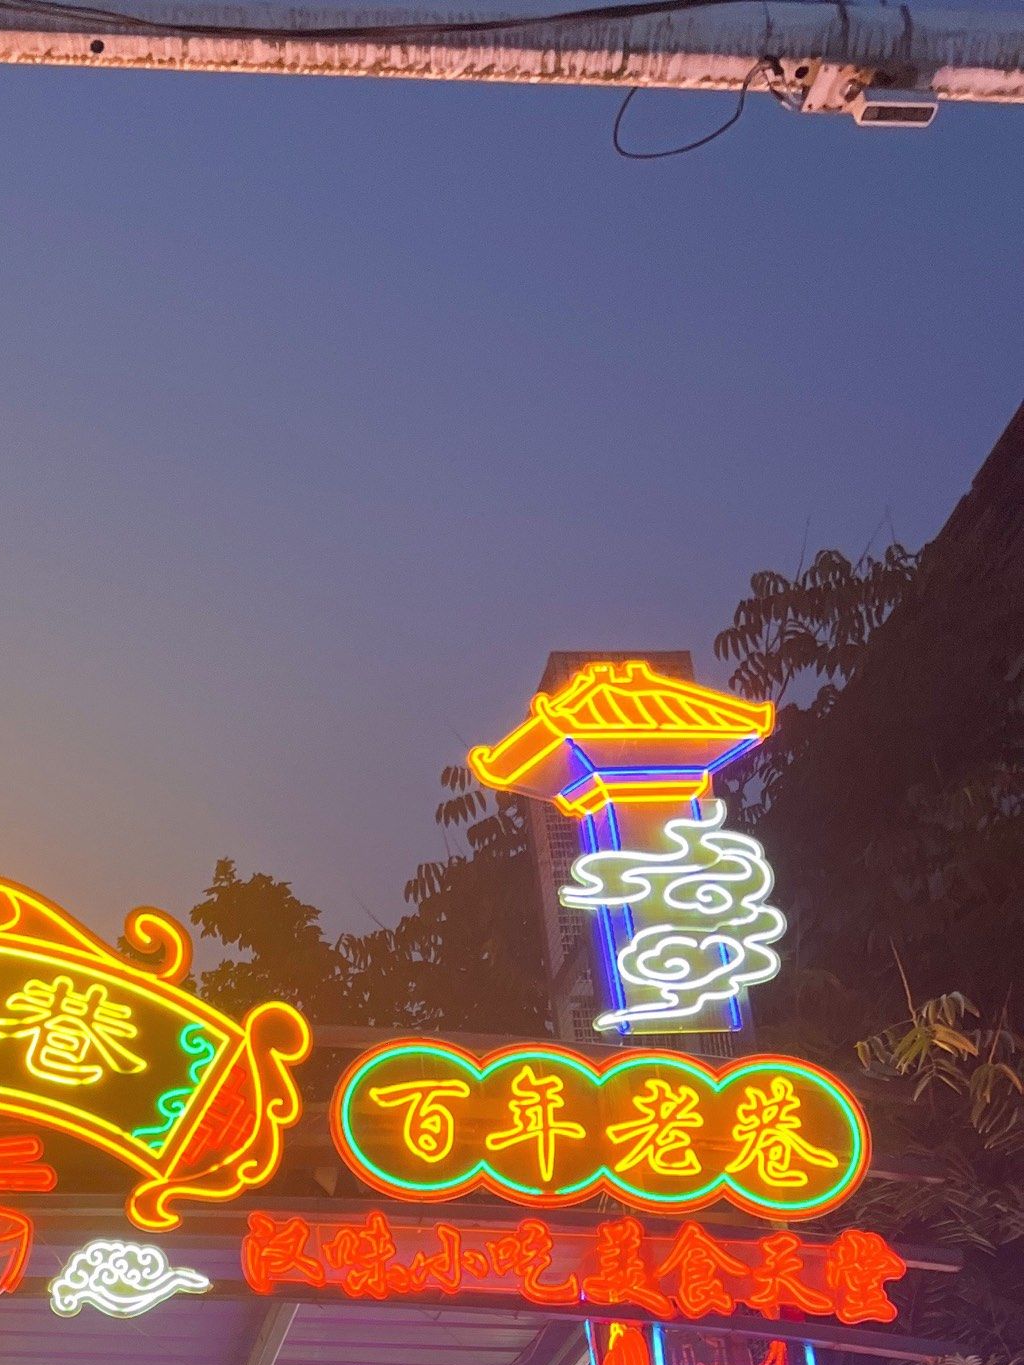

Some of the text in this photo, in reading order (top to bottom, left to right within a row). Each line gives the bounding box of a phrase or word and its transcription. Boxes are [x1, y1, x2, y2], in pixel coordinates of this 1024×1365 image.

[369, 1064, 840, 1188] 百年老巷
[243, 1211, 907, 1325] 汉味小吃美食天堂
